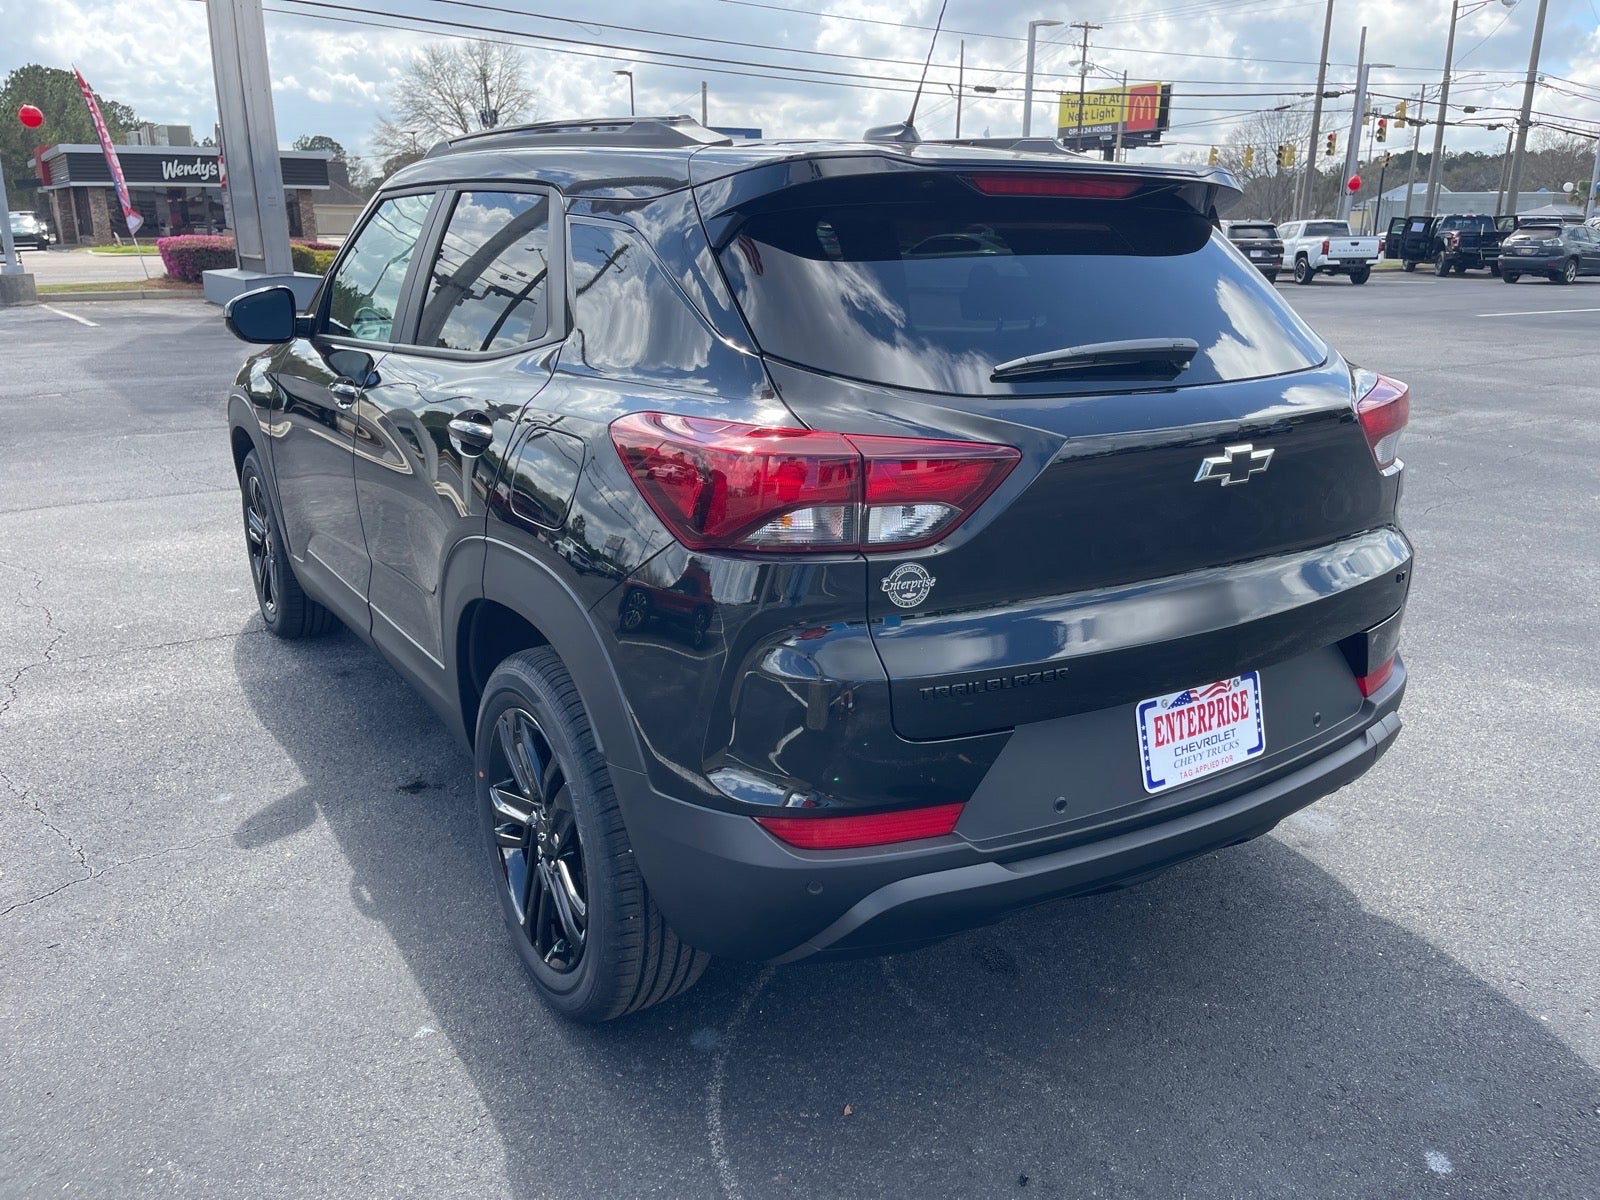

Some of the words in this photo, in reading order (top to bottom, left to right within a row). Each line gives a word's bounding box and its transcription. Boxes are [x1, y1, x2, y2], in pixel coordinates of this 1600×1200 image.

[1066, 97, 1084, 109] Tur
[1087, 94, 1106, 106] Left
[1109, 93, 1120, 104] At
[1091, 107, 1115, 121] Light
[1084, 126, 1092, 134] 24
[1092, 124, 1113, 133] HOURS
[161, 157, 218, 180] Wendy's
[881, 577, 936, 592] Enterprise
[919, 667, 1069, 700] TRAILBLAZER
[1153, 689, 1249, 748] ENTERPRISE
[1173, 751, 1206, 769] CHEVY
[1207, 739, 1240, 758] TRUCKS
[1174, 728, 1237, 757] CHEVROLET
[1180, 769, 1193, 780] TAG
[1195, 760, 1220, 774] APPLIED
[1221, 754, 1234, 766] FOR
